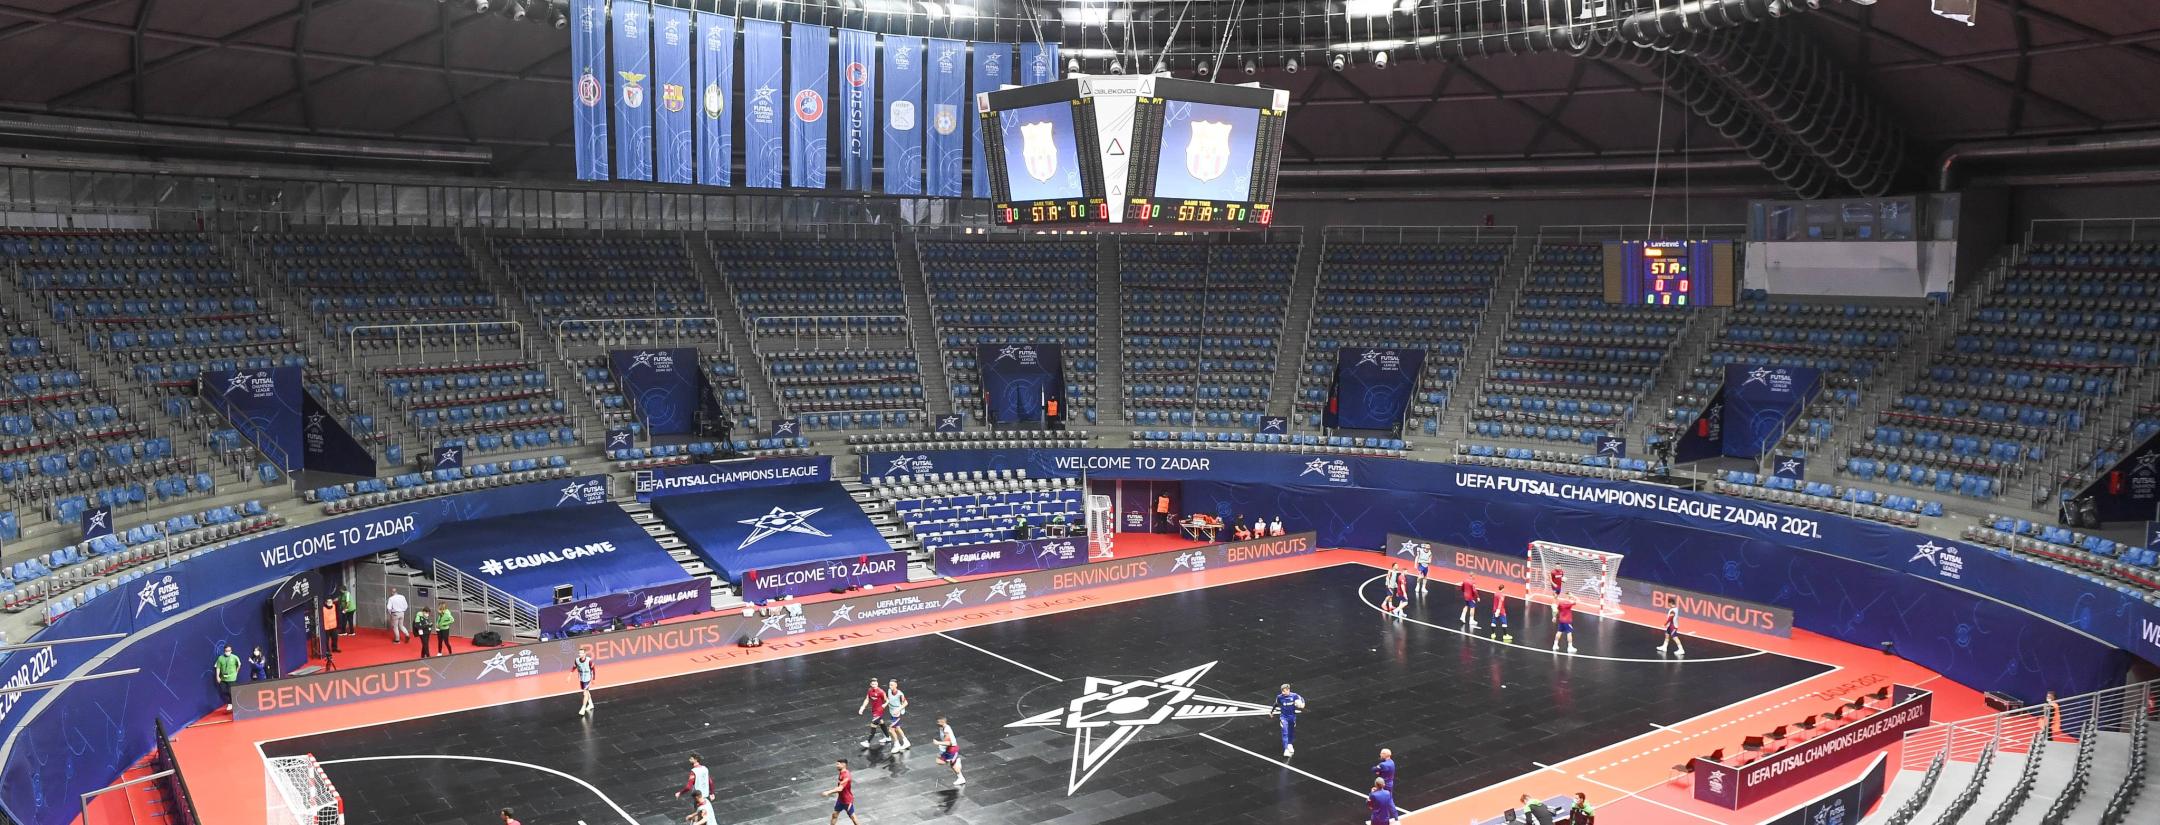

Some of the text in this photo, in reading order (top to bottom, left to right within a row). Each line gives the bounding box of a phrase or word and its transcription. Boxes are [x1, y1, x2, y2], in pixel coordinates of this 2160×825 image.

[851, 89, 862, 157] RESPECT
[1006, 207, 1013, 223] 0
[1013, 207, 1019, 220] 0
[1032, 207, 1044, 221] 57
[1070, 205, 1076, 217] 0
[1079, 204, 1085, 217] 0
[1100, 203, 1107, 219] 0
[1141, 204, 1151, 220] 0
[1152, 204, 1160, 218] 0
[1178, 206, 1194, 221] 57
[1227, 208, 1235, 220] 0
[1237, 208, 1245, 221] 0
[1261, 209, 1271, 224] 0
[1651, 262, 1665, 274] 57
[1655, 279, 1688, 292] 0 0
[1647, 294, 1685, 305] 0 0 0
[1055, 456, 1210, 470] WELCOME TO ZADAR
[665, 474, 708, 488] FUTSAL
[709, 471, 774, 484] CHAMPIONS
[775, 466, 818, 479] LEAGUE
[583, 485, 605, 493] FUTSAL
[1455, 472, 1496, 490] UEFA
[1497, 476, 1559, 497] FUTSAL
[1560, 484, 1656, 510] CHAMPIONS
[1658, 497, 1722, 520] LEAGUE
[1723, 506, 1778, 530] ZADAR
[260, 515, 415, 568] WELCOME TO ZADAR
[1227, 537, 1306, 562] BENVINGUTS
[1940, 552, 1963, 564] FUTSAL
[755, 559, 896, 589] WELCOME TO ZADAR
[1053, 561, 1147, 590] BENVINGUTS
[158, 582, 179, 595] FUTSAL
[876, 596, 921, 608] UEFA FUTSAL
[585, 606, 603, 614] FUTSAL
[857, 606, 898, 619] CHAMPIONS
[898, 602, 924, 613] LEAGUE
[1652, 590, 1774, 629] BENVINGUTS
[785, 615, 806, 623] FUTSAL
[691, 595, 1097, 664] UEFA FUTSAL CHAMPIONS LEAGUE
[581, 625, 720, 660] BENVINGUTS
[512, 655, 539, 664] FUTSAL
[257, 667, 433, 712] BENVINGUTS
[1747, 767, 1771, 787] UEFA
[1770, 753, 1805, 778] FUTSAL
[1805, 734, 1853, 763] CHAMPIONS
[1852, 720, 1884, 744] LEAGUE
[1882, 711, 1907, 732] ZADAR
